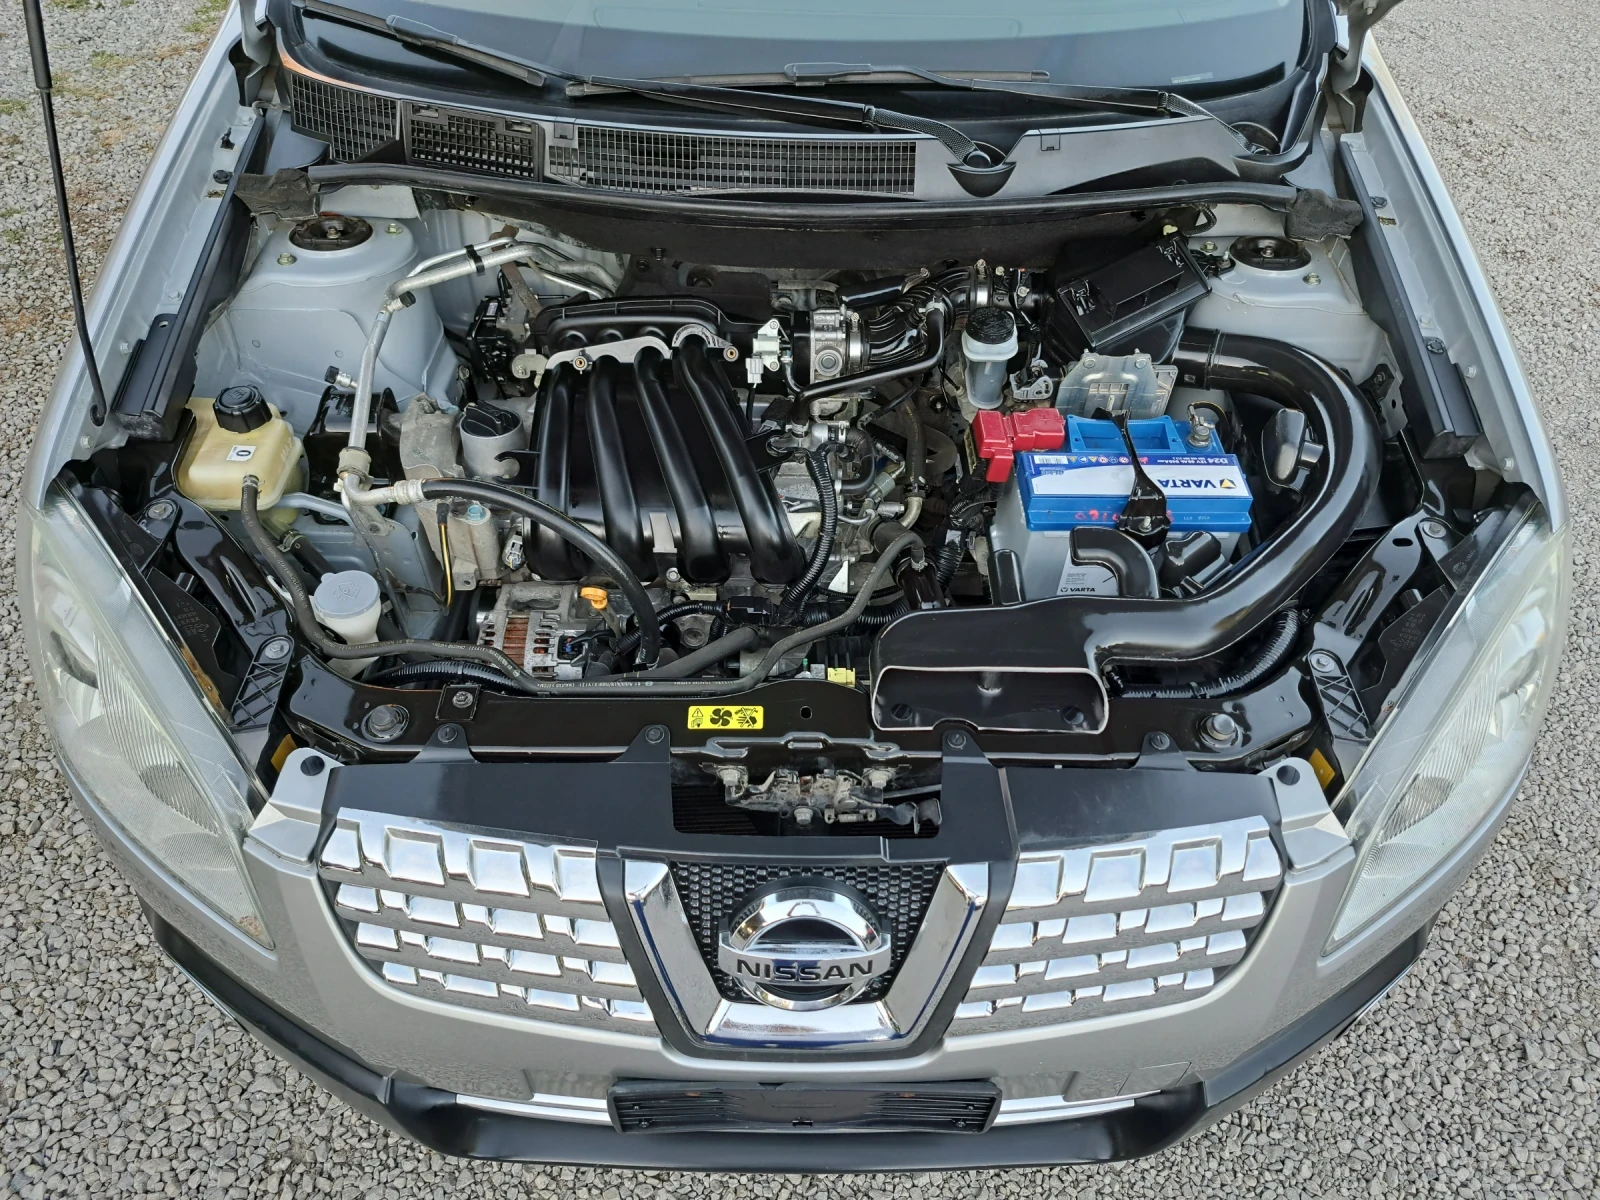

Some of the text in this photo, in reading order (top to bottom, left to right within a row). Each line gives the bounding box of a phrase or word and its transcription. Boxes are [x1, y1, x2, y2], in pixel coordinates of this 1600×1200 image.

[1207, 457, 1229, 465] D24
[1157, 479, 1217, 489] VARTA
[737, 959, 873, 981] NISSAN
